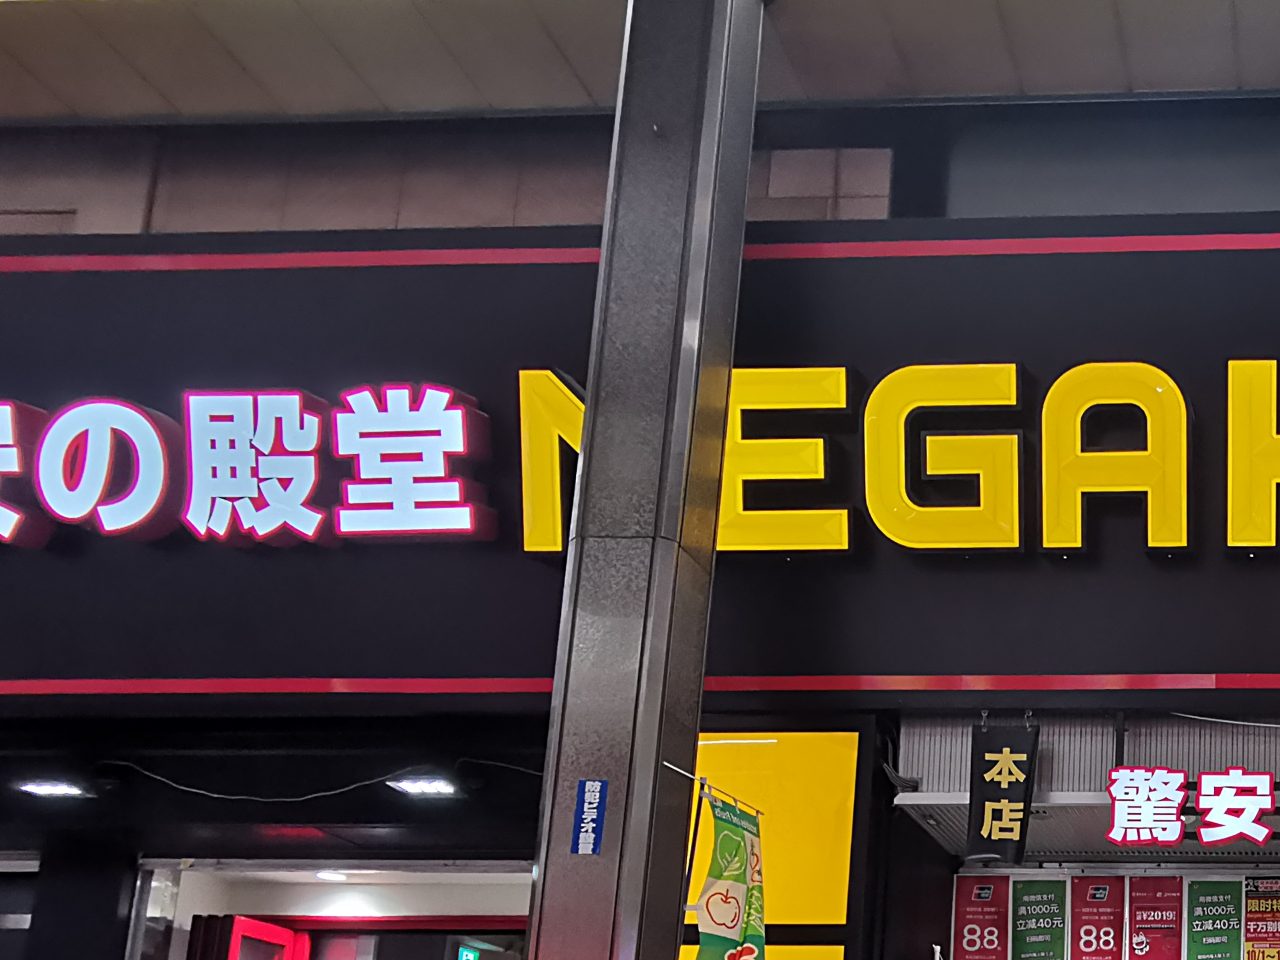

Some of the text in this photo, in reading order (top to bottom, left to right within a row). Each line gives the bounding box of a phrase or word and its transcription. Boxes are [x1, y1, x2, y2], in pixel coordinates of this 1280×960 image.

[0, 386, 475, 541] の殿堂
[981, 748, 1028, 841] 本店
[1018, 904, 1059, 915] 满1000元
[1194, 905, 1235, 916] 满1000元
[1016, 917, 1063, 930] 立减40元
[1192, 919, 1239, 931] 立减40元
